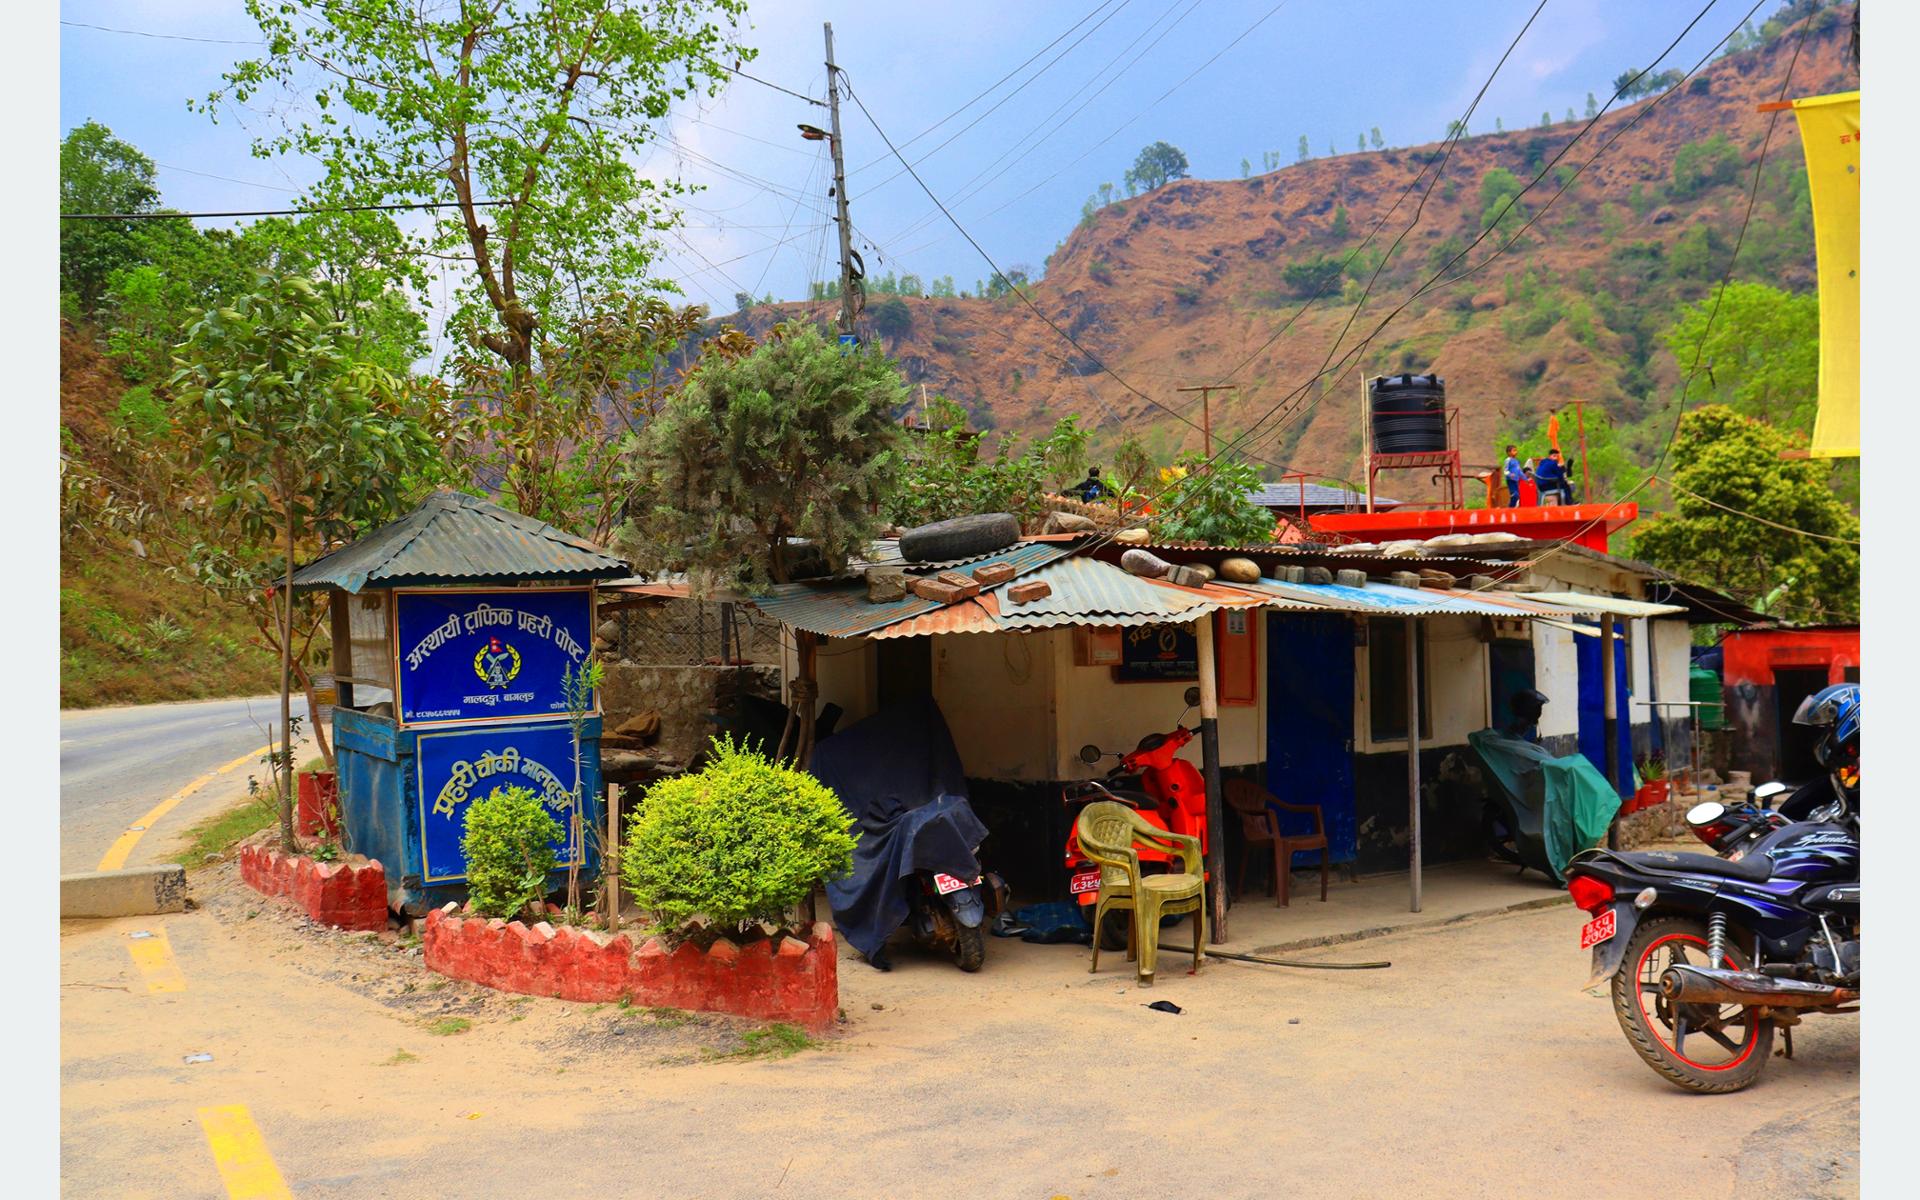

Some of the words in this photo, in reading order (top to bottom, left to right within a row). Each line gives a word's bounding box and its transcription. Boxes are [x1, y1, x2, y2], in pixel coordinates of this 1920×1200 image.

[405, 613, 461, 671] अस्थायी
[464, 603, 513, 635] ट्राफिक
[517, 610, 553, 639] प्रहरी
[555, 626, 585, 663] पोष्ट
[432, 760, 478, 821] प्रहरी
[474, 746, 521, 778] चौकी
